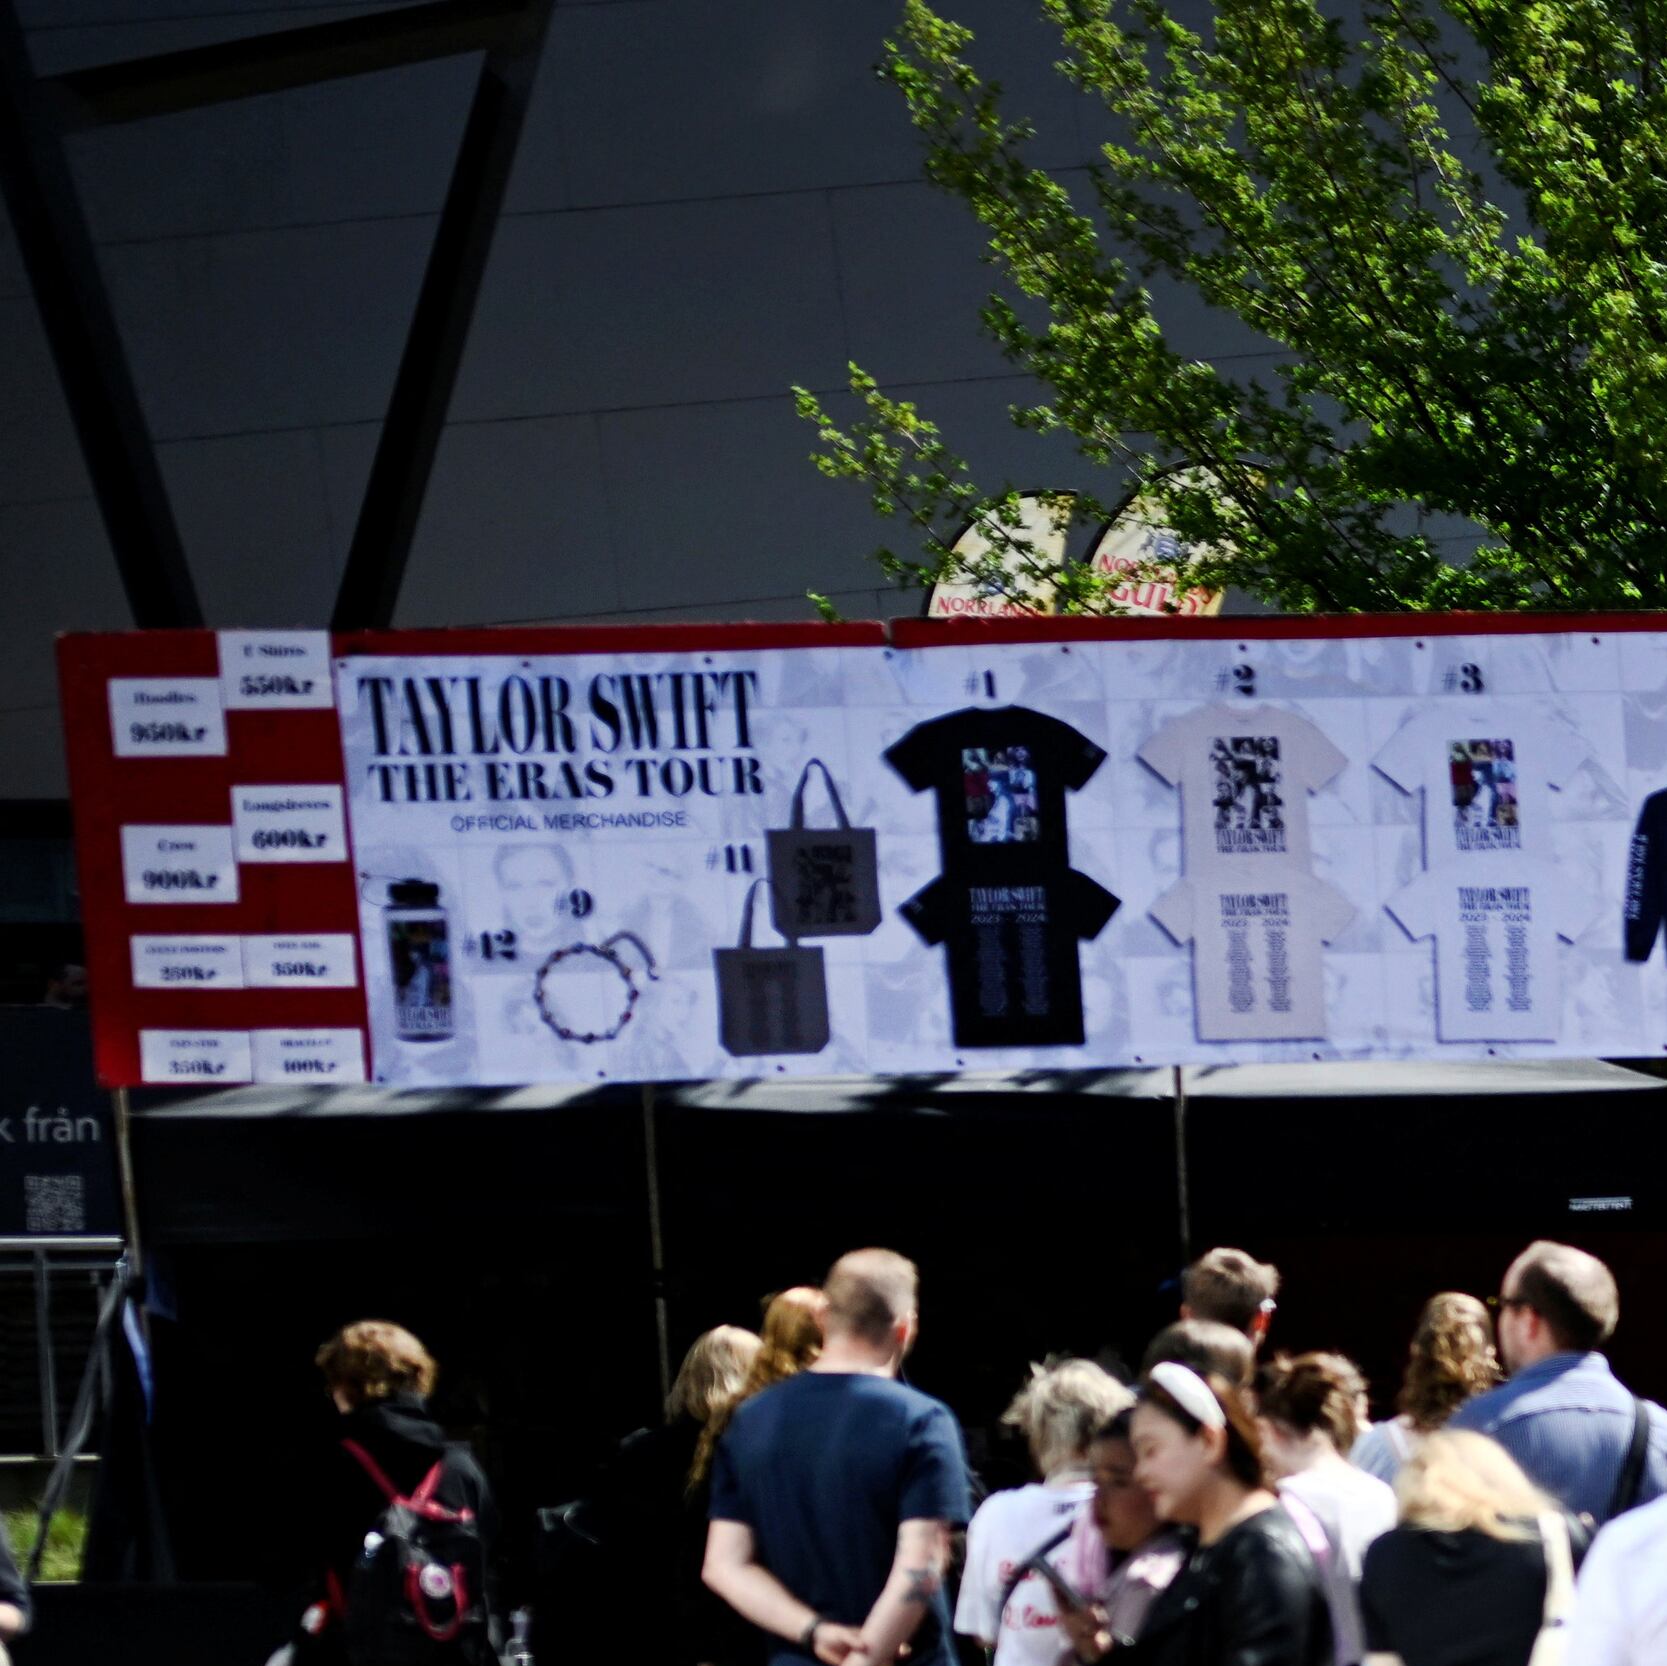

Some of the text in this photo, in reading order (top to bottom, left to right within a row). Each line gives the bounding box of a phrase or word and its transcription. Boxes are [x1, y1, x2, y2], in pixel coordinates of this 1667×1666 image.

[240, 675, 314, 696] 550kr
[963, 669, 996, 699] #1
[1214, 664, 1257, 698] #2
[1441, 662, 1485, 694] #3
[133, 691, 197, 704] Hoodies
[357, 670, 761, 756] TAYLOR SWIFT
[129, 721, 207, 743] 950kr
[367, 756, 765, 802] THE ERAS TOUR
[451, 811, 688, 832] OFFICIAL MERCHANDISE
[252, 828, 328, 849] 600kr
[705, 843, 754, 874] #11
[142, 869, 219, 889] 900kr
[554, 887, 595, 919] #9
[463, 928, 518, 962] #12
[23, 1105, 100, 1143] från
